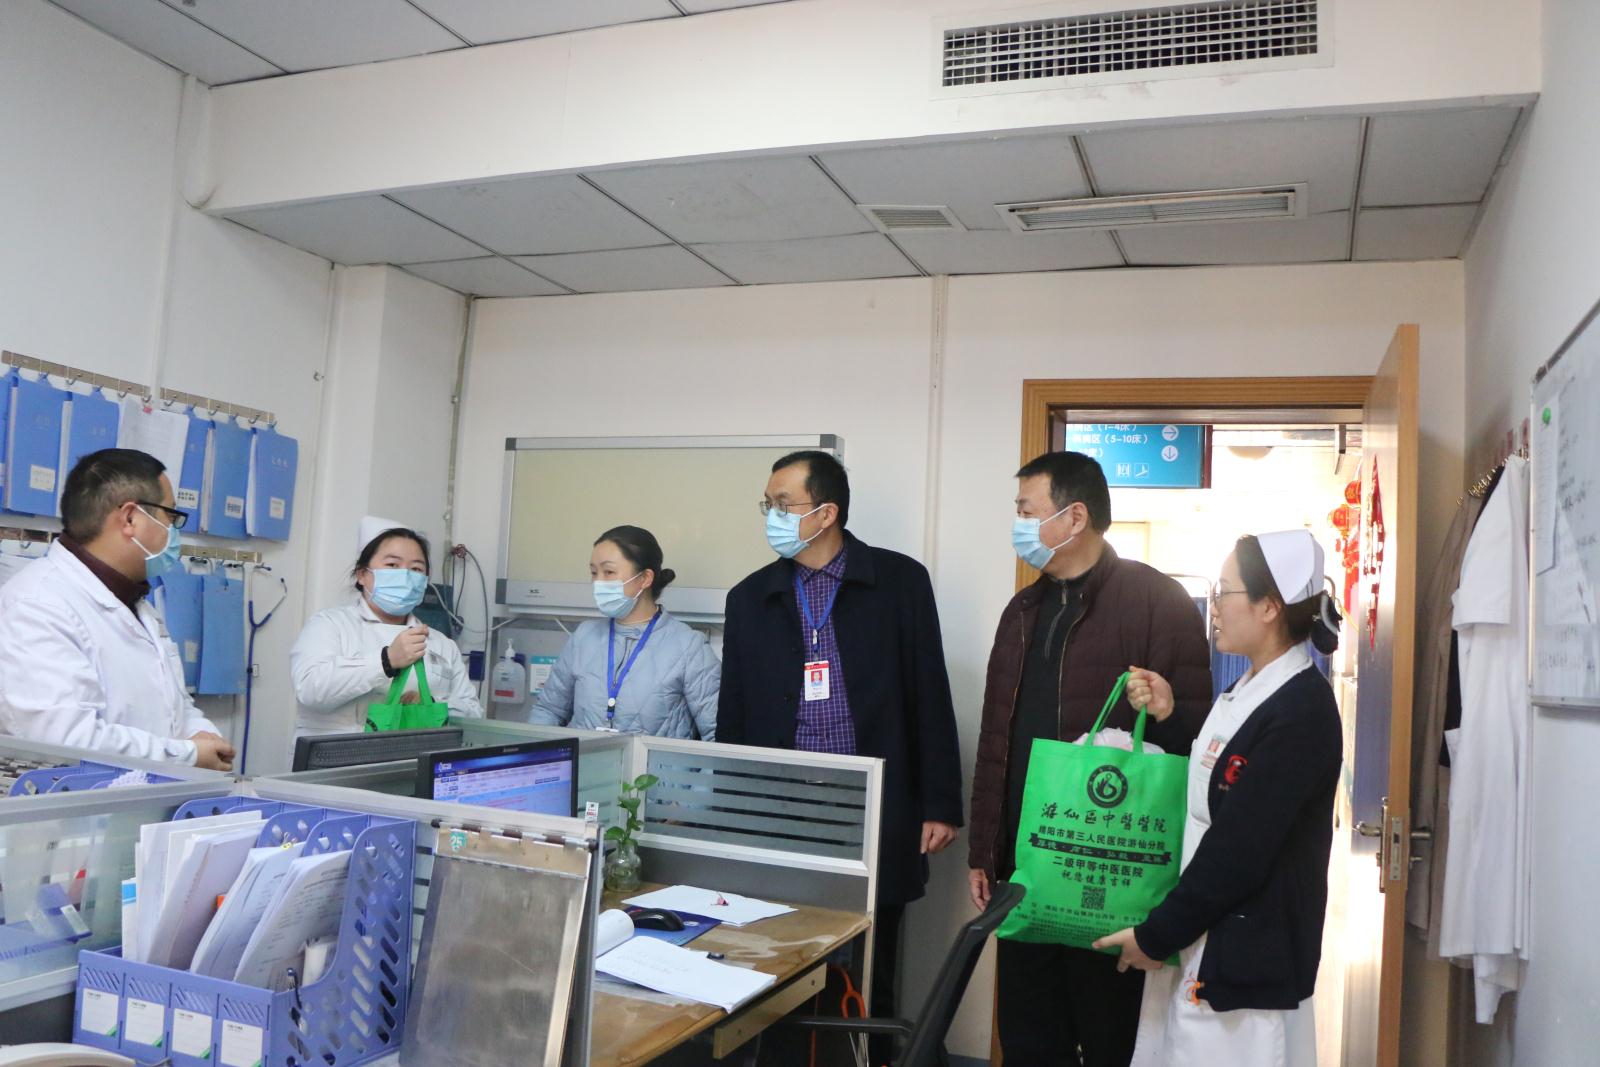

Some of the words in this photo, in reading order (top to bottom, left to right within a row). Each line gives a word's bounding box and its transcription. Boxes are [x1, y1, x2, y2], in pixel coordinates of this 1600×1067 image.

[1052, 855, 1144, 878] 二级甲等中医医院
